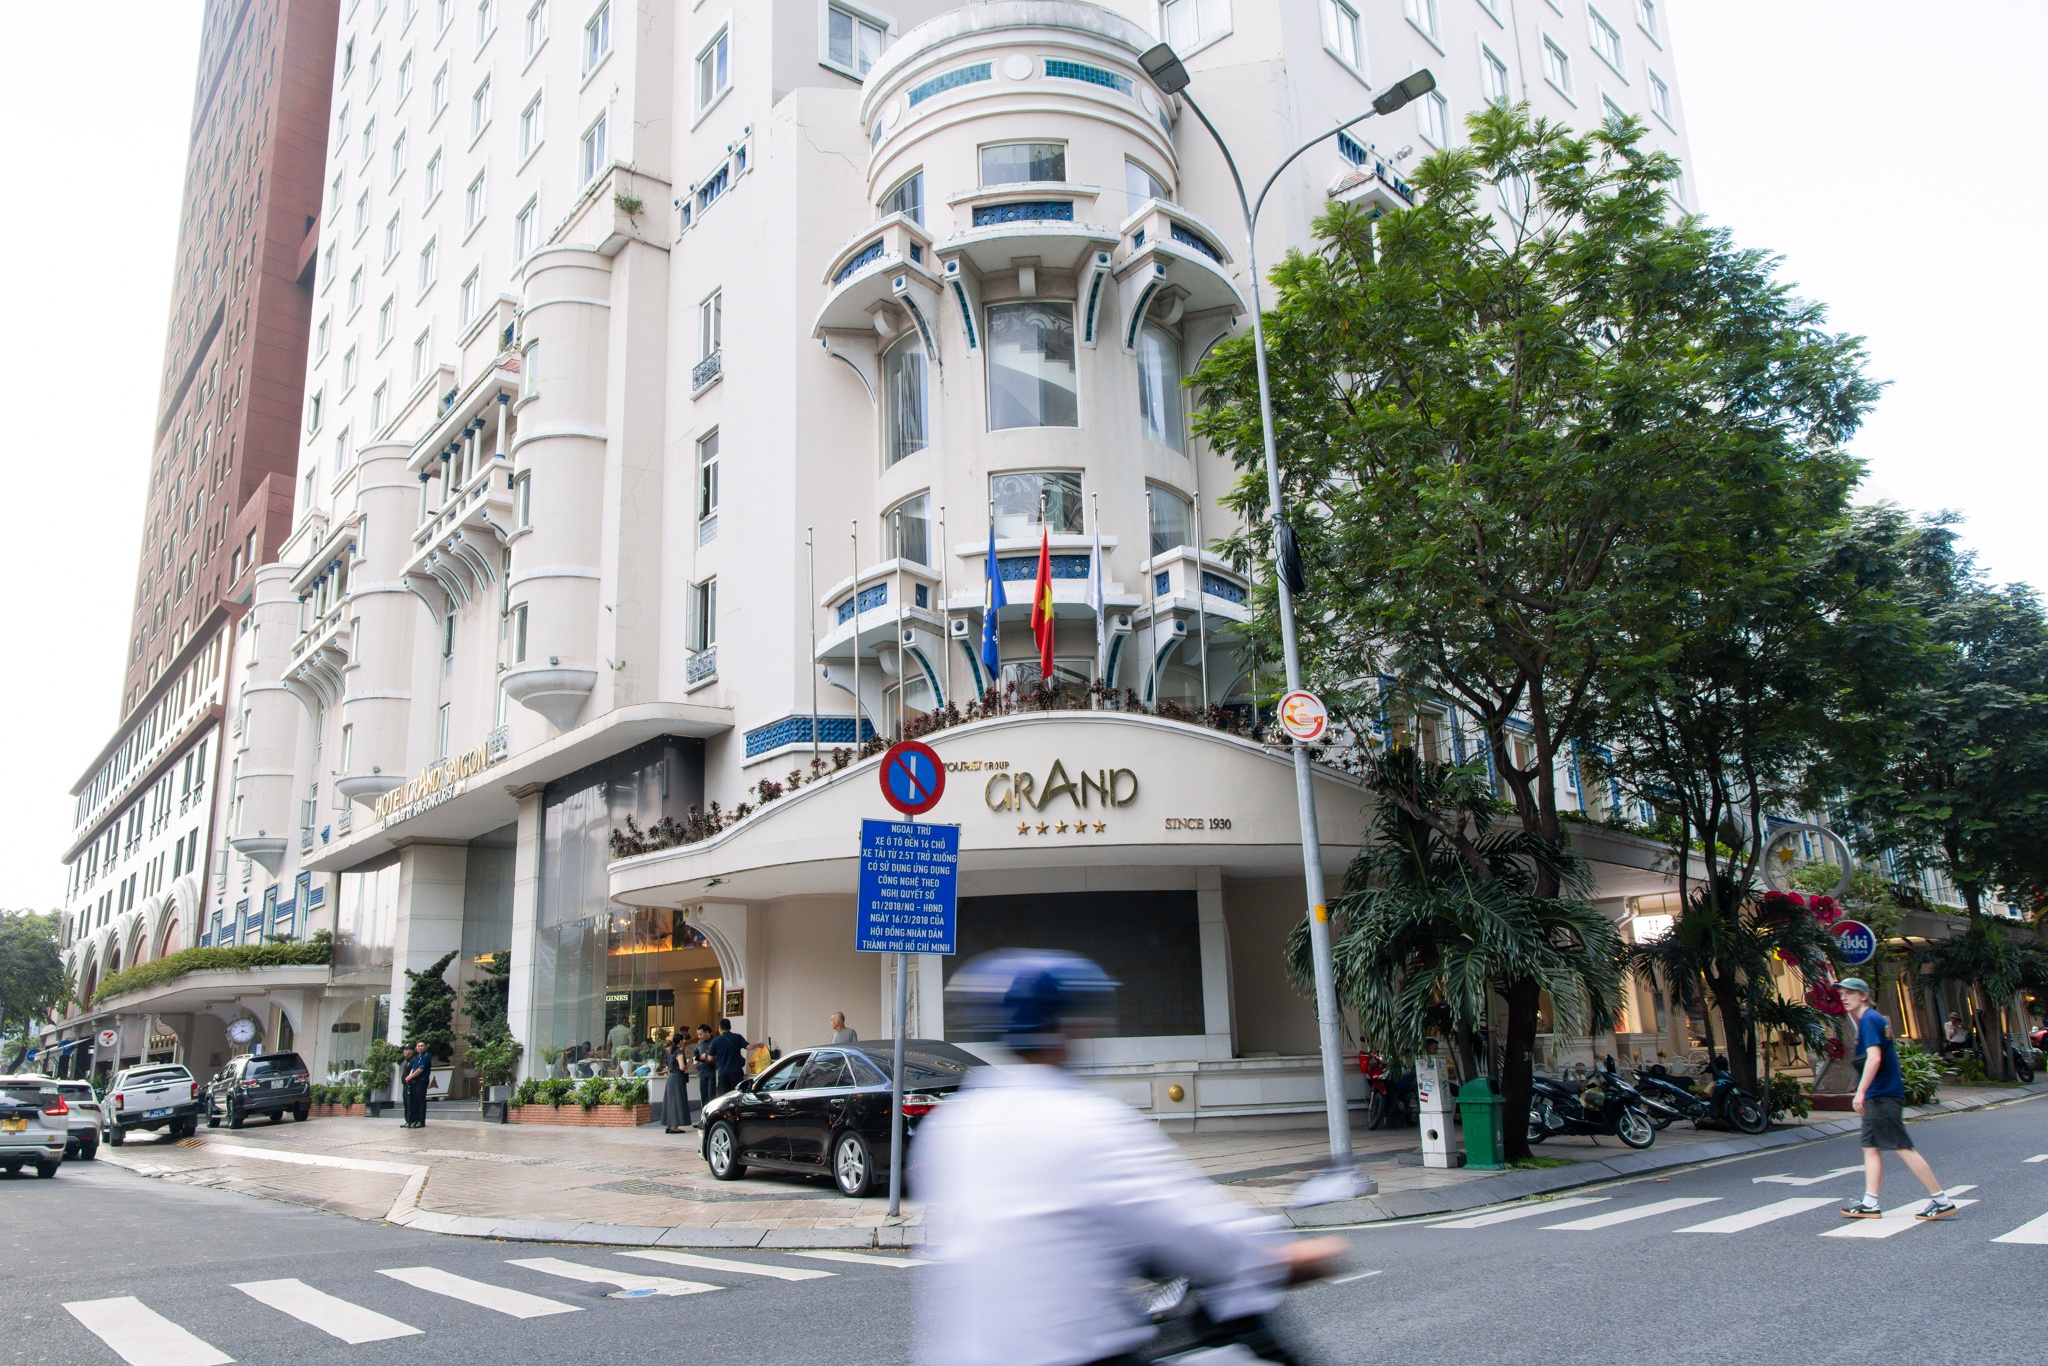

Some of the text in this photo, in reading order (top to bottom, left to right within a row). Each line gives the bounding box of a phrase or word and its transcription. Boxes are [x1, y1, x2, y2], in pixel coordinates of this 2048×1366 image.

[984, 761, 1010, 771] GROUP
[375, 741, 489, 821] HOTEL GRAND SAIGON
[985, 757, 1140, 812] GRAND
[891, 824, 931, 835] NGOẠI TRỪ
[1164, 817, 1232, 831] SINCE 1930
[875, 835, 946, 849] XE Ô TÔ ĐẾN 16 CHỖ
[862, 847, 957, 863] XE TẢI TỪ 2.5T TRỞ XUỐNG
[868, 860, 950, 877] CÓ SỬ DỤNG ỨNG DỤNG
[878, 875, 940, 888] CÔNG NGHỆ THEO
[881, 887, 936, 900] NGHỊ QUYẾT SỐ
[872, 900, 915, 912] 01/2018/NQ
[923, 903, 943, 913] HĐND
[870, 912, 944, 926] NGÀY 16/3/2018 CỦA
[870, 924, 943, 939] HỘI ĐỒNG NHÂN DÂN
[862, 938, 950, 952] THÀNH PHỐ HỒ CHÍ MINH
